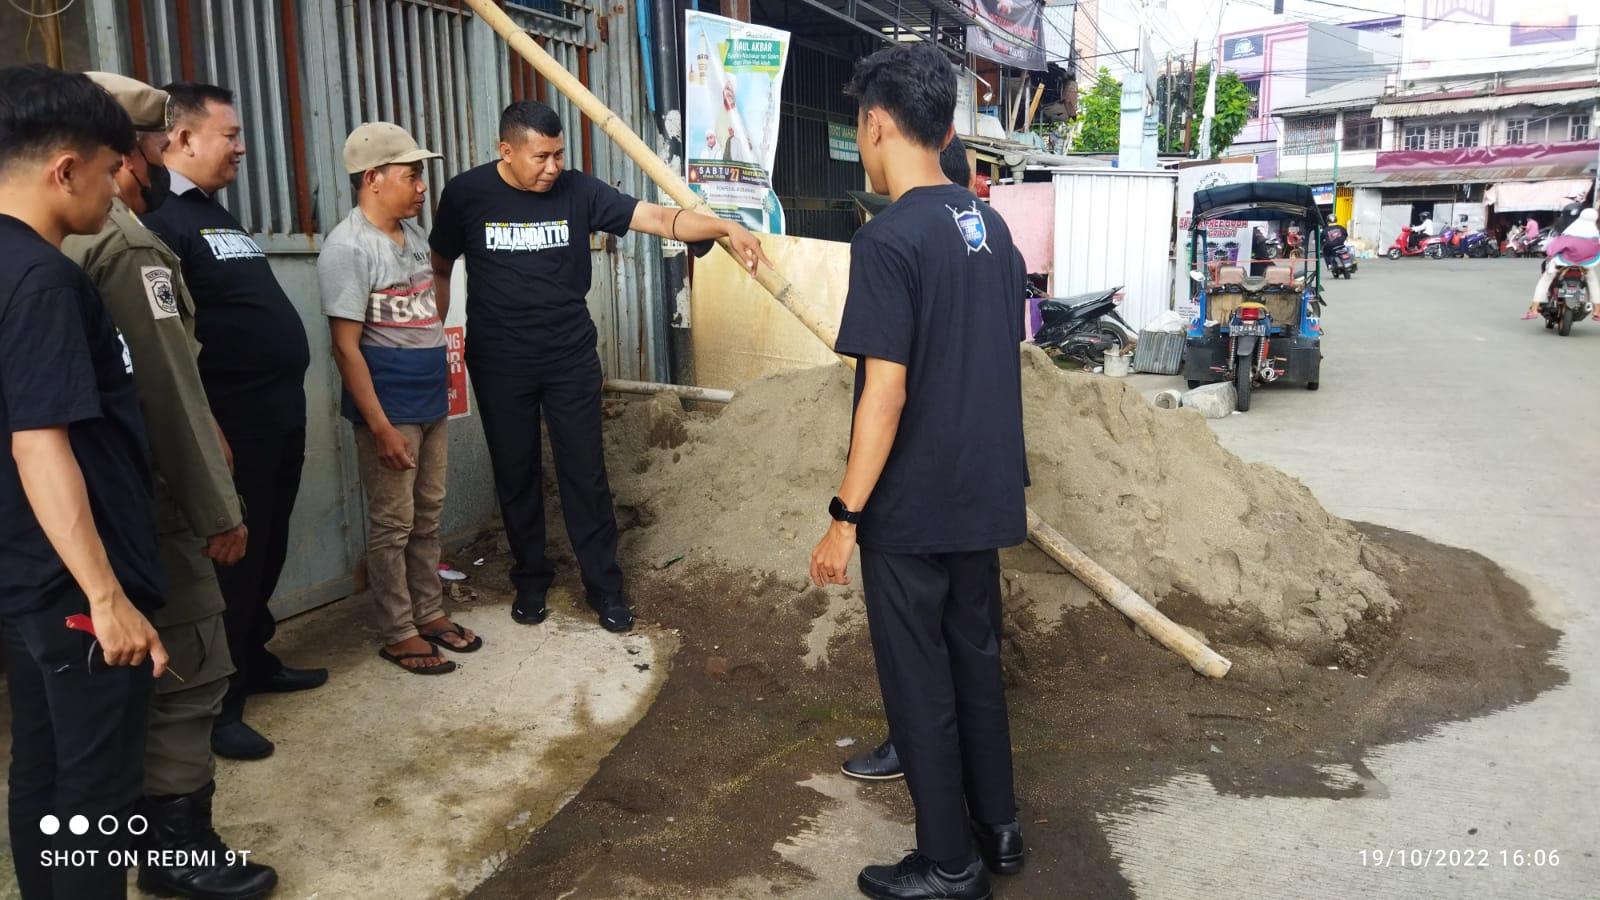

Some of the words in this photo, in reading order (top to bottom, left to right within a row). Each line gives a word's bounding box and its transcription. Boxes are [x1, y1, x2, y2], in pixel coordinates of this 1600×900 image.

[751, 41, 773, 52] AKBAR
[698, 166, 730, 176] SABTU
[730, 167, 740, 182] 27
[485, 224, 570, 252] PAKANDATTO
